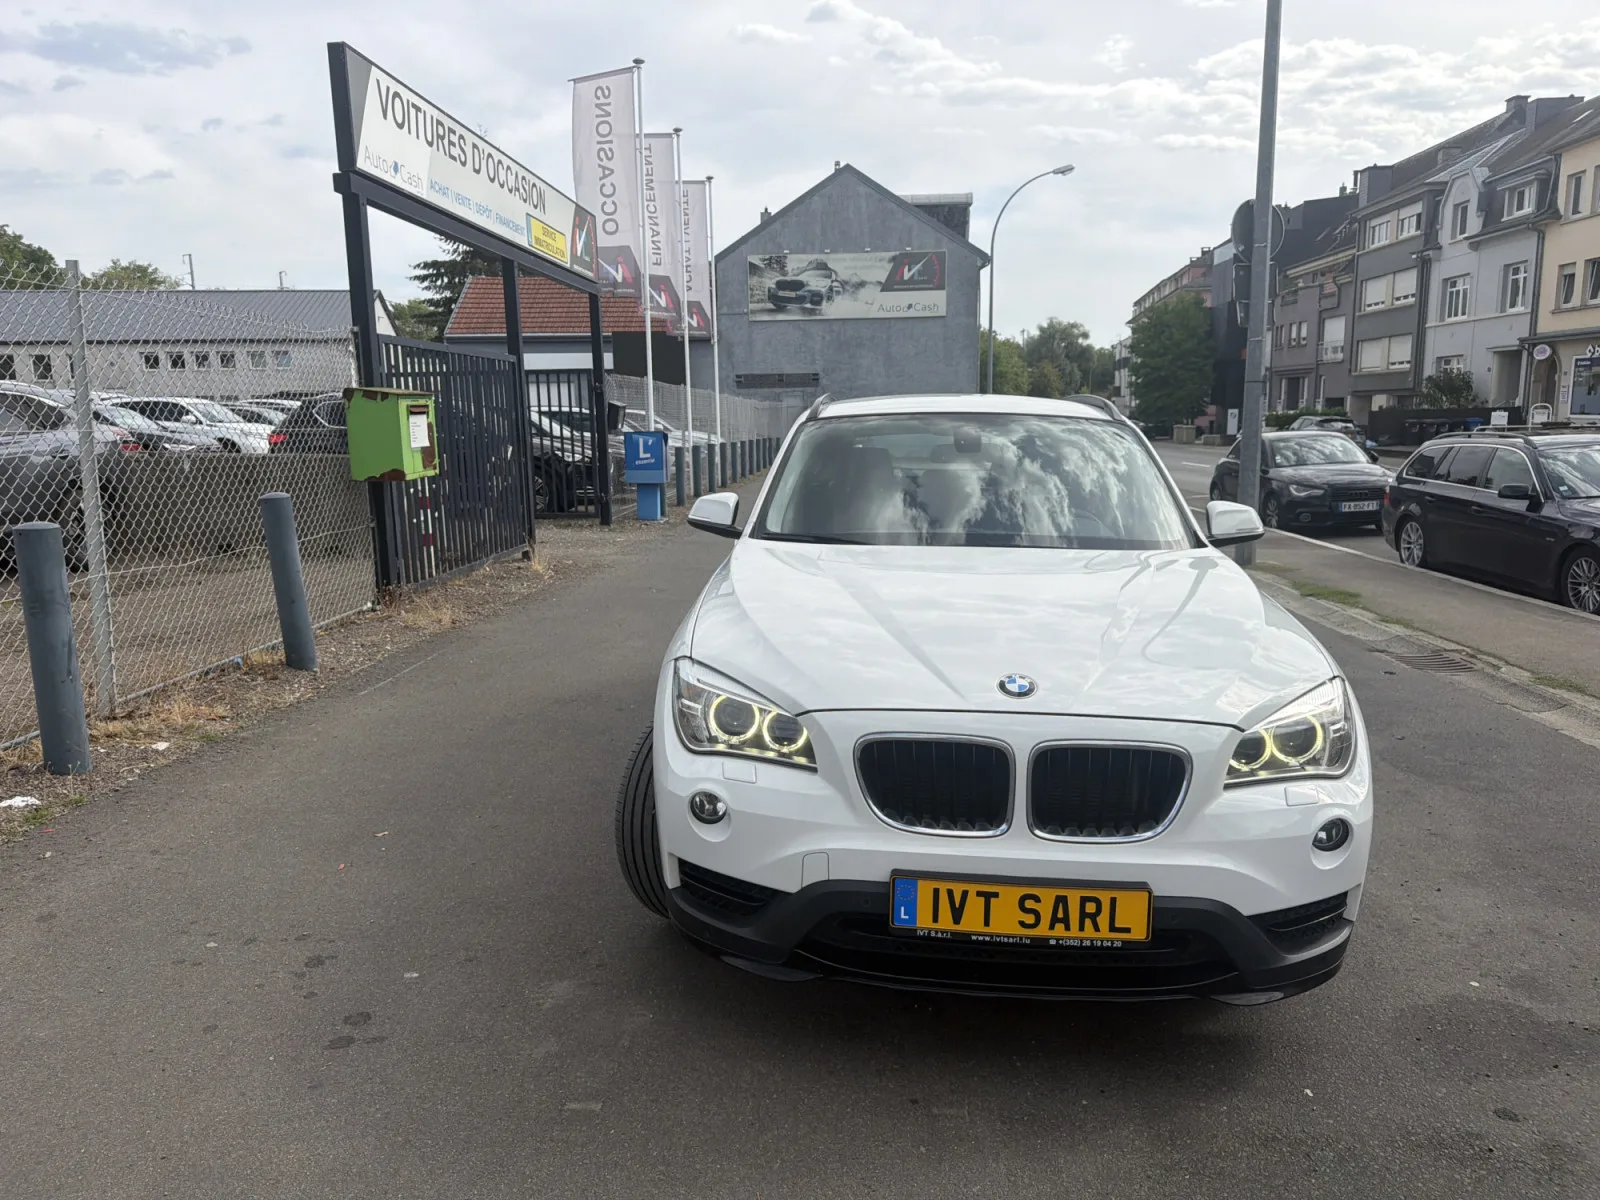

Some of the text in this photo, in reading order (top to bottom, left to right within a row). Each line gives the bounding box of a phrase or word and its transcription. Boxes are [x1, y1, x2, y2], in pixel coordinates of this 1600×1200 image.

[376, 77, 546, 215] VOITURES D'OCCASION
[364, 144, 424, 191] Auto Cash
[430, 179, 449, 199] ACHAT
[454, 194, 472, 211] VENTE
[877, 302, 939, 313] Auto Cash
[900, 887, 1132, 934] L IVT SARL
[971, 934, 1031, 945] www.ivtsarl.lu
[1082, 939, 1091, 947] 26
[1102, 940, 1112, 948] 04
